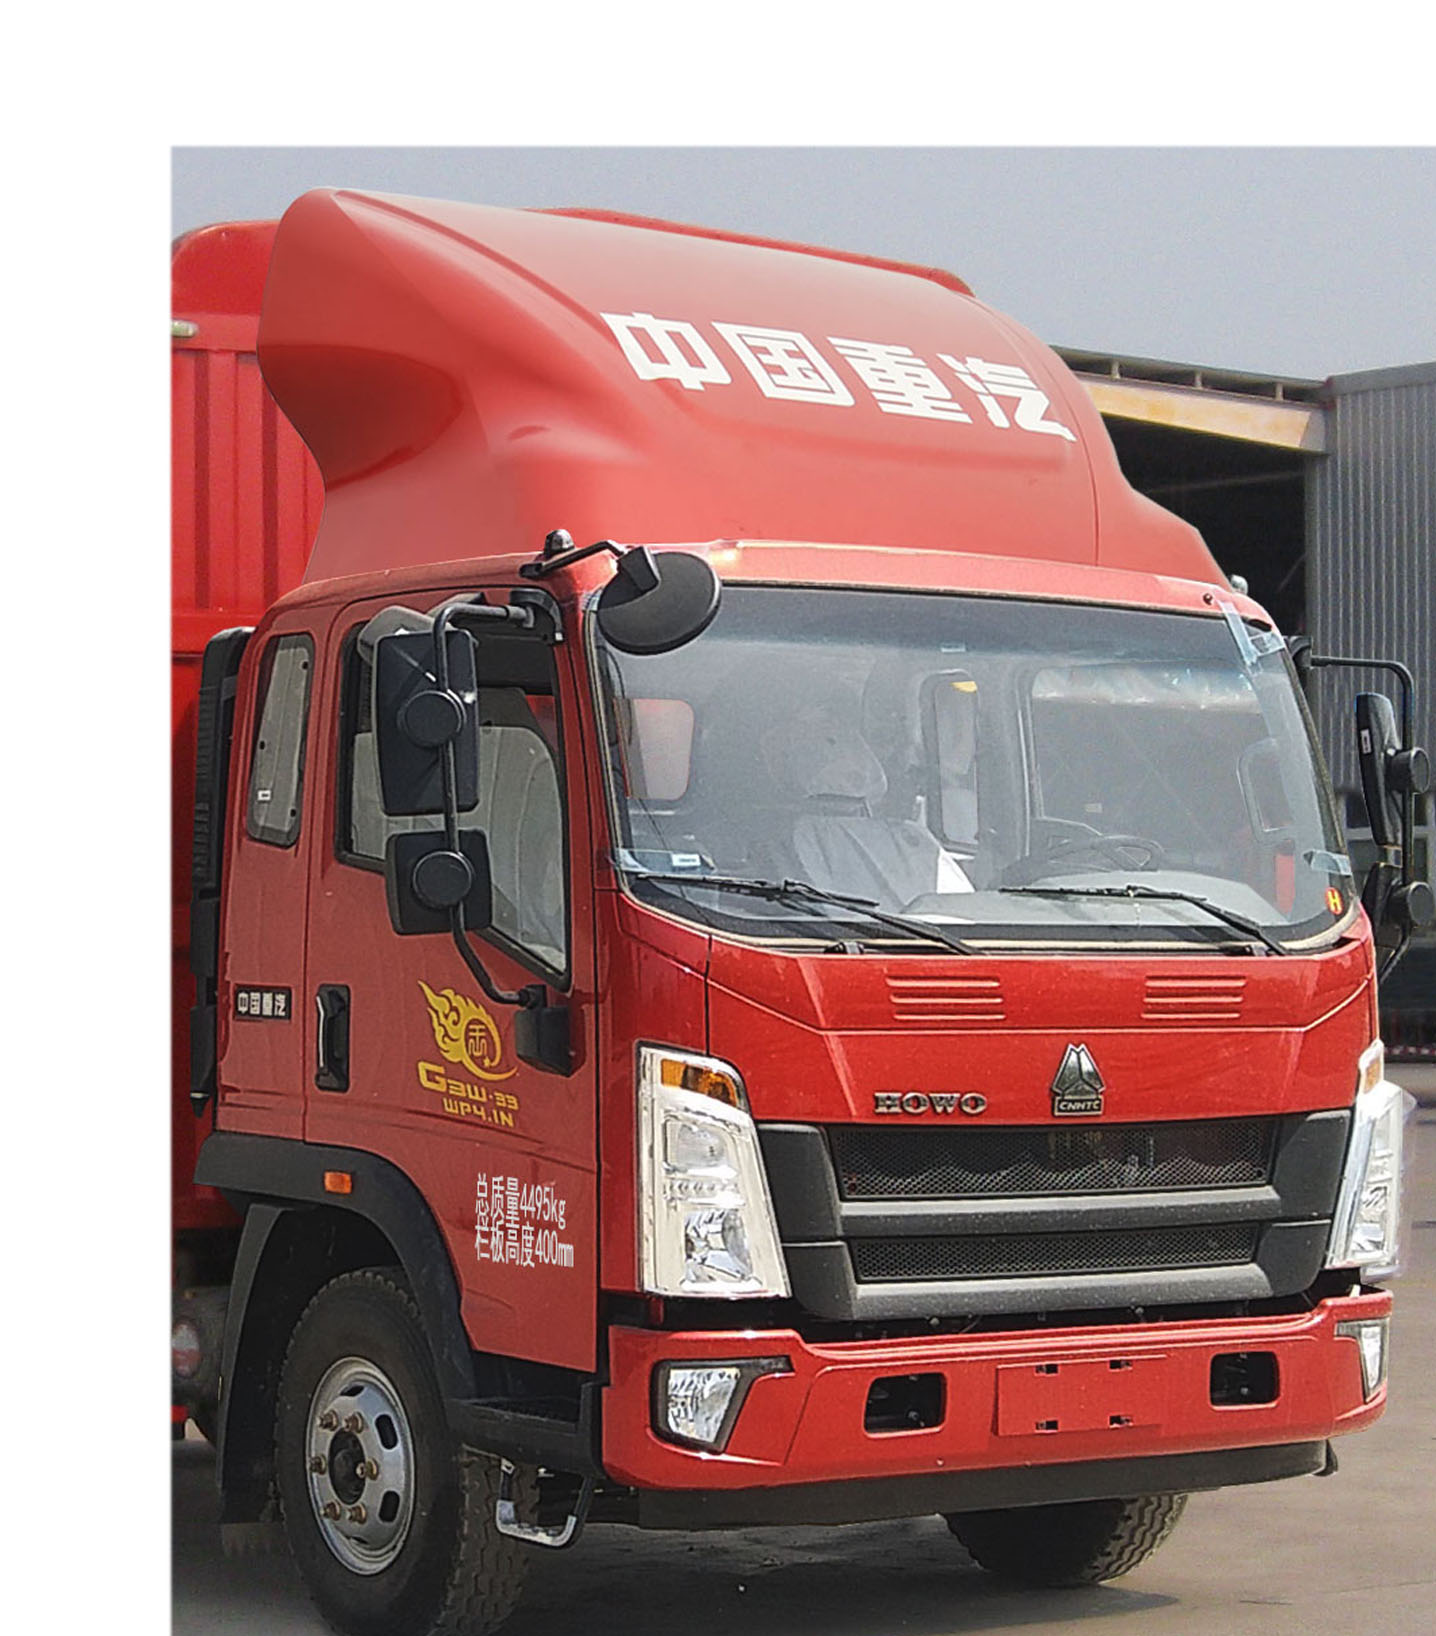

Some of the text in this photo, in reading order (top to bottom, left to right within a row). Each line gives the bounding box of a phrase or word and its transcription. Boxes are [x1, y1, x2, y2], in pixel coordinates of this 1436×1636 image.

[599, 312, 1077, 442] 中国重汽
[874, 1091, 986, 1115] HOWO
